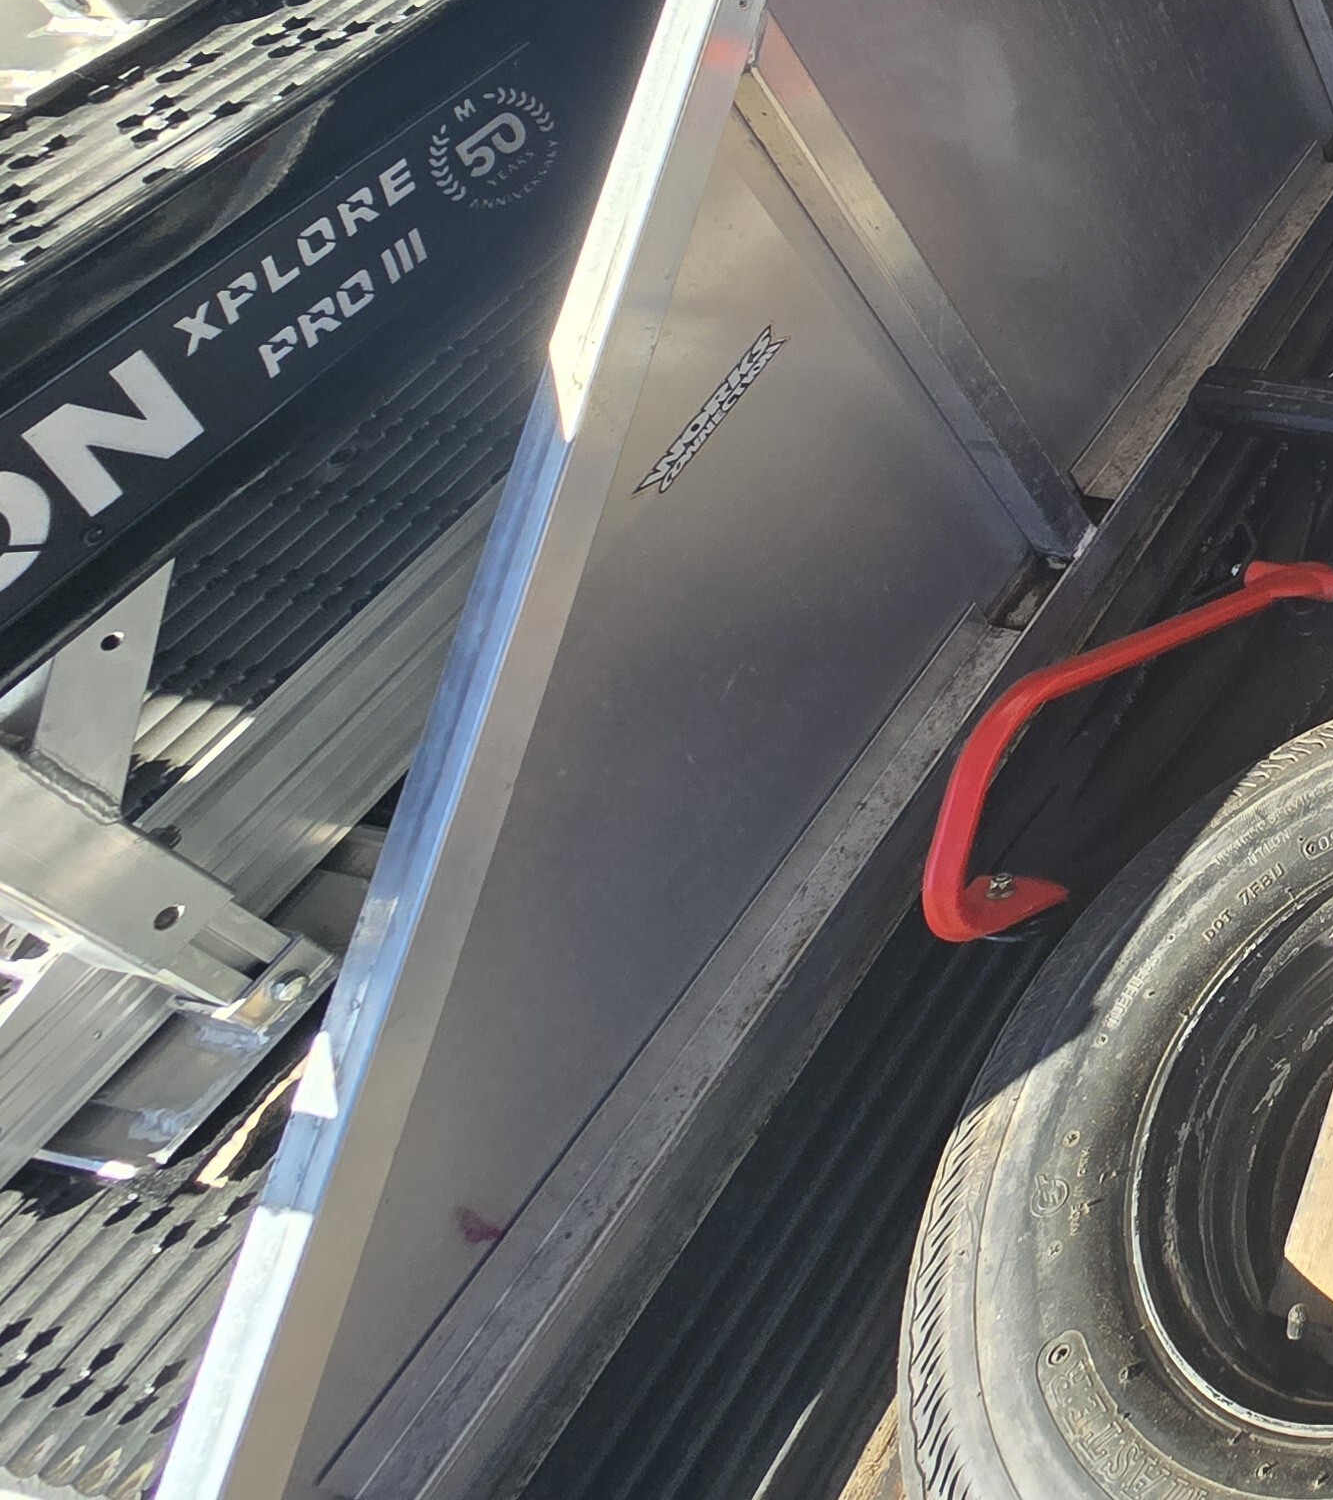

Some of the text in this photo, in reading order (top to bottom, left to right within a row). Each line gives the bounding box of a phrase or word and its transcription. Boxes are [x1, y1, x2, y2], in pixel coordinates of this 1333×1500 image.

[454, 98, 477, 123] M
[455, 112, 526, 177] 50
[486, 150, 535, 187] YEARS
[173, 157, 417, 357] XPLORE
[258, 269, 375, 379] PRO
[634, 326, 771, 490] WORKS
[659, 341, 785, 493] CONNECTION
[1203, 908, 1234, 943] DOT
